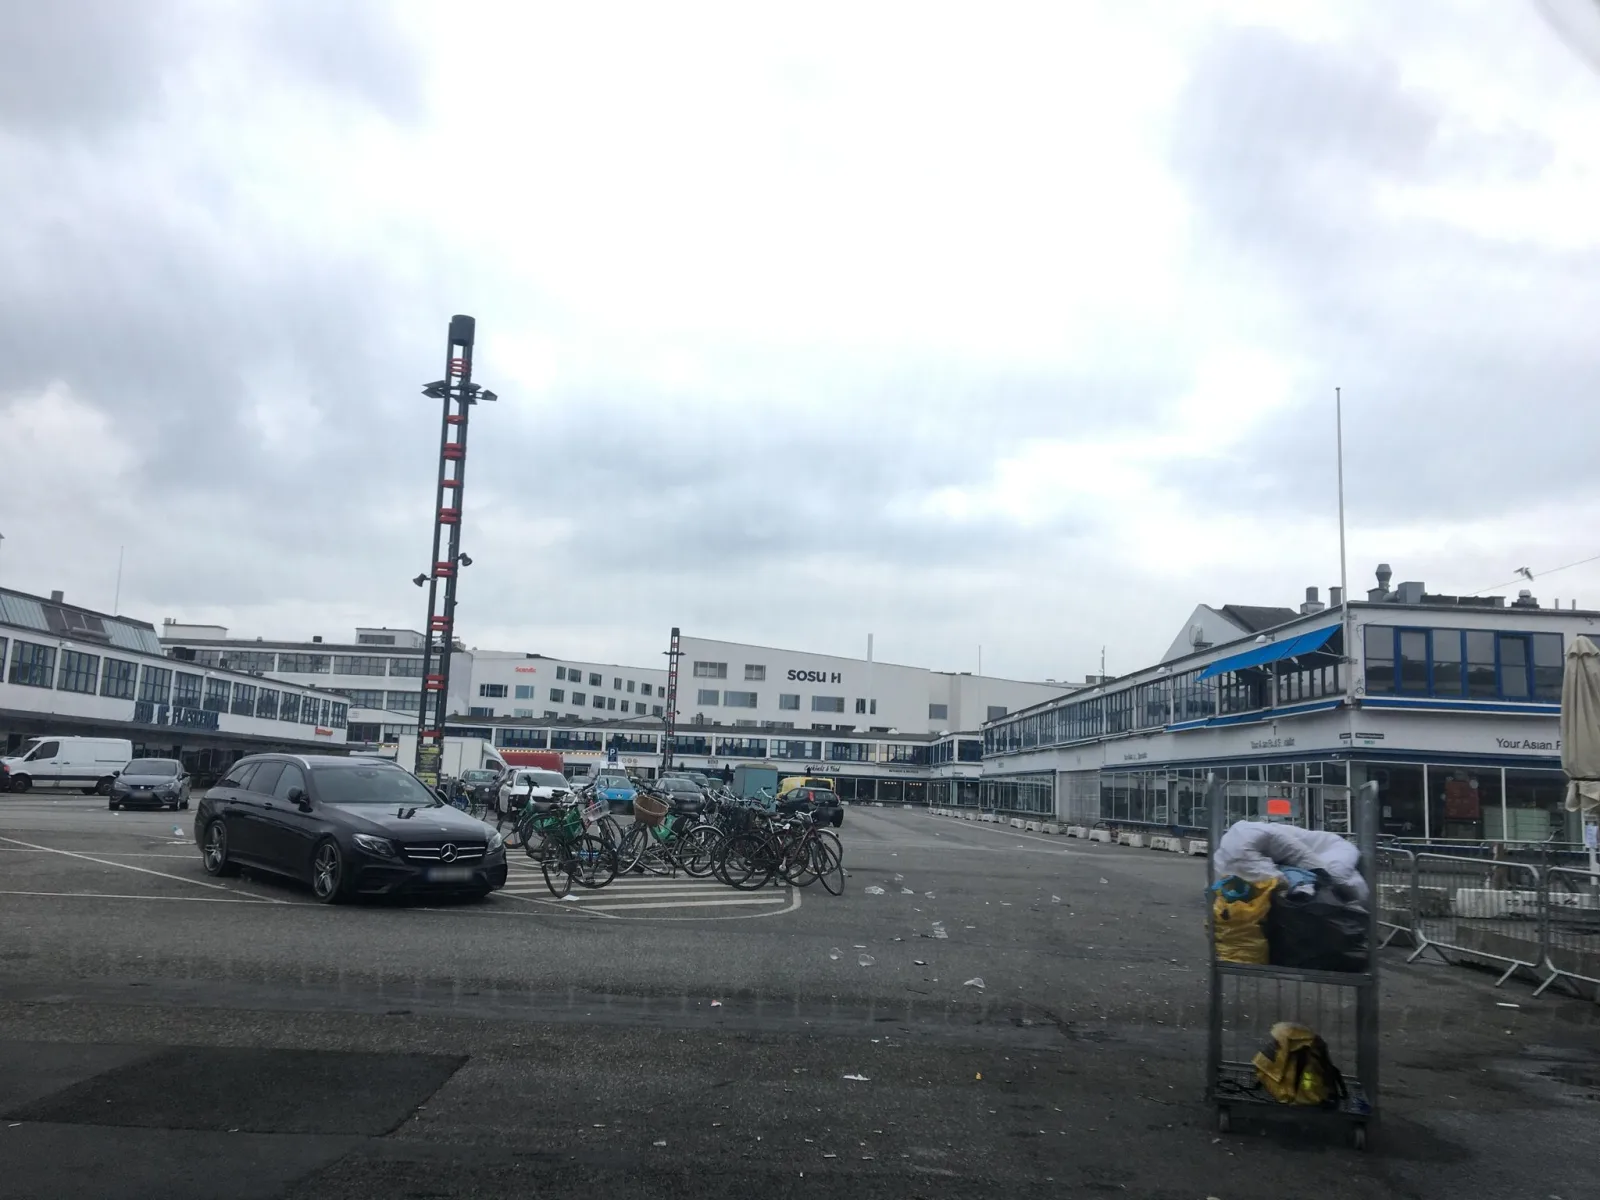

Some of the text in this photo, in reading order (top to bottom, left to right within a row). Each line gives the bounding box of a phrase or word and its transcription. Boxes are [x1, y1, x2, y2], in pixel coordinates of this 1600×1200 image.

[787, 669, 842, 684] SOSU H
[1495, 737, 1520, 749] Your
[1522, 739, 1553, 750] Asian
